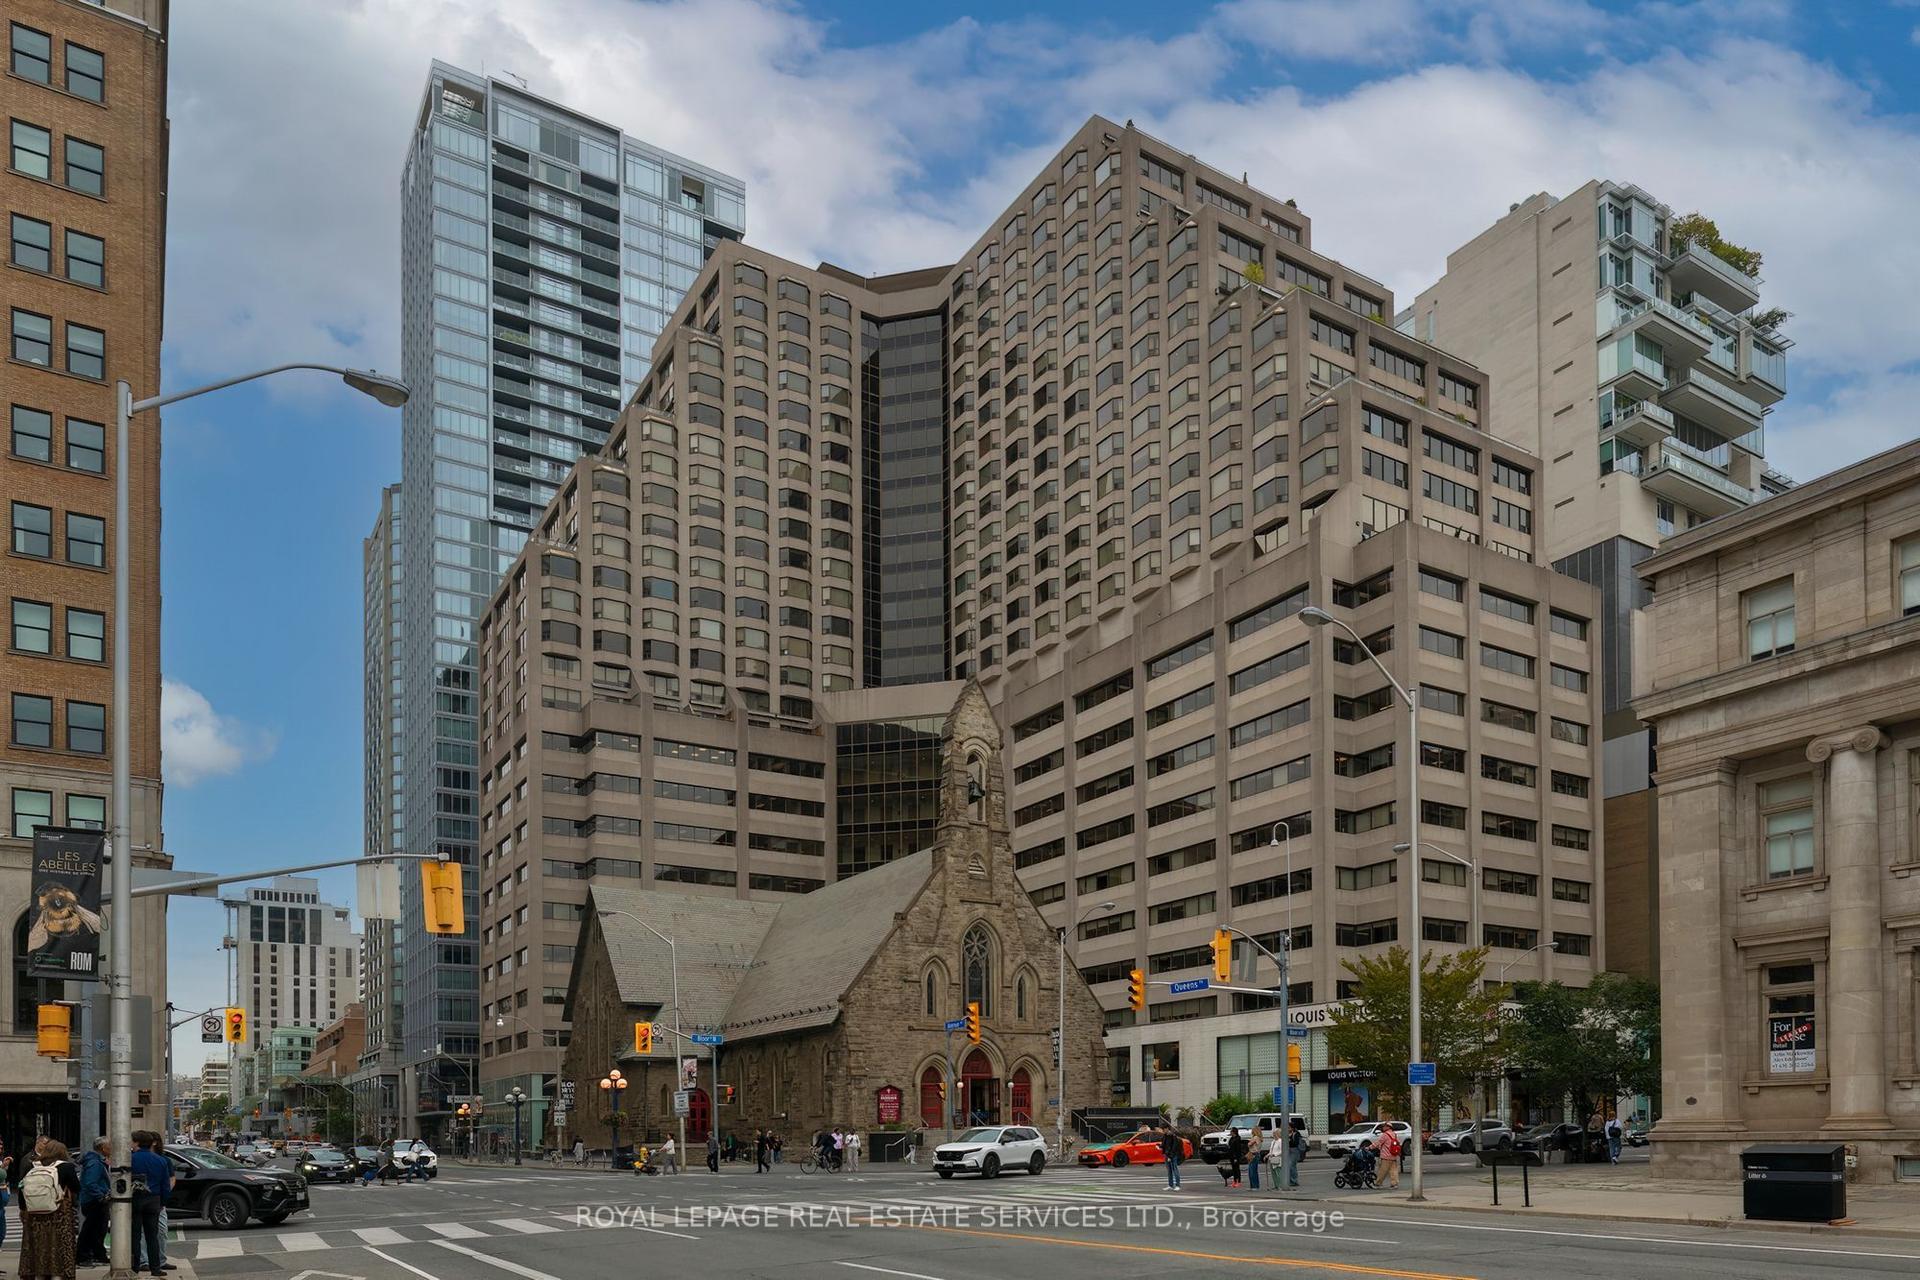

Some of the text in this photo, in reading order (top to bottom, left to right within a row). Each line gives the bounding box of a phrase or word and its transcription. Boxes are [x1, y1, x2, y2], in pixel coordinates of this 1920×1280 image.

[57, 850, 80, 862] LES
[38, 859, 97, 873] ABEILLES
[70, 951, 92, 971] ROM
[1174, 982, 1198, 992] Queens
[1290, 1009, 1325, 1024] LOUIS
[1773, 1021, 1791, 1032] For
[1327, 1071, 1347, 1080] LOUIS
